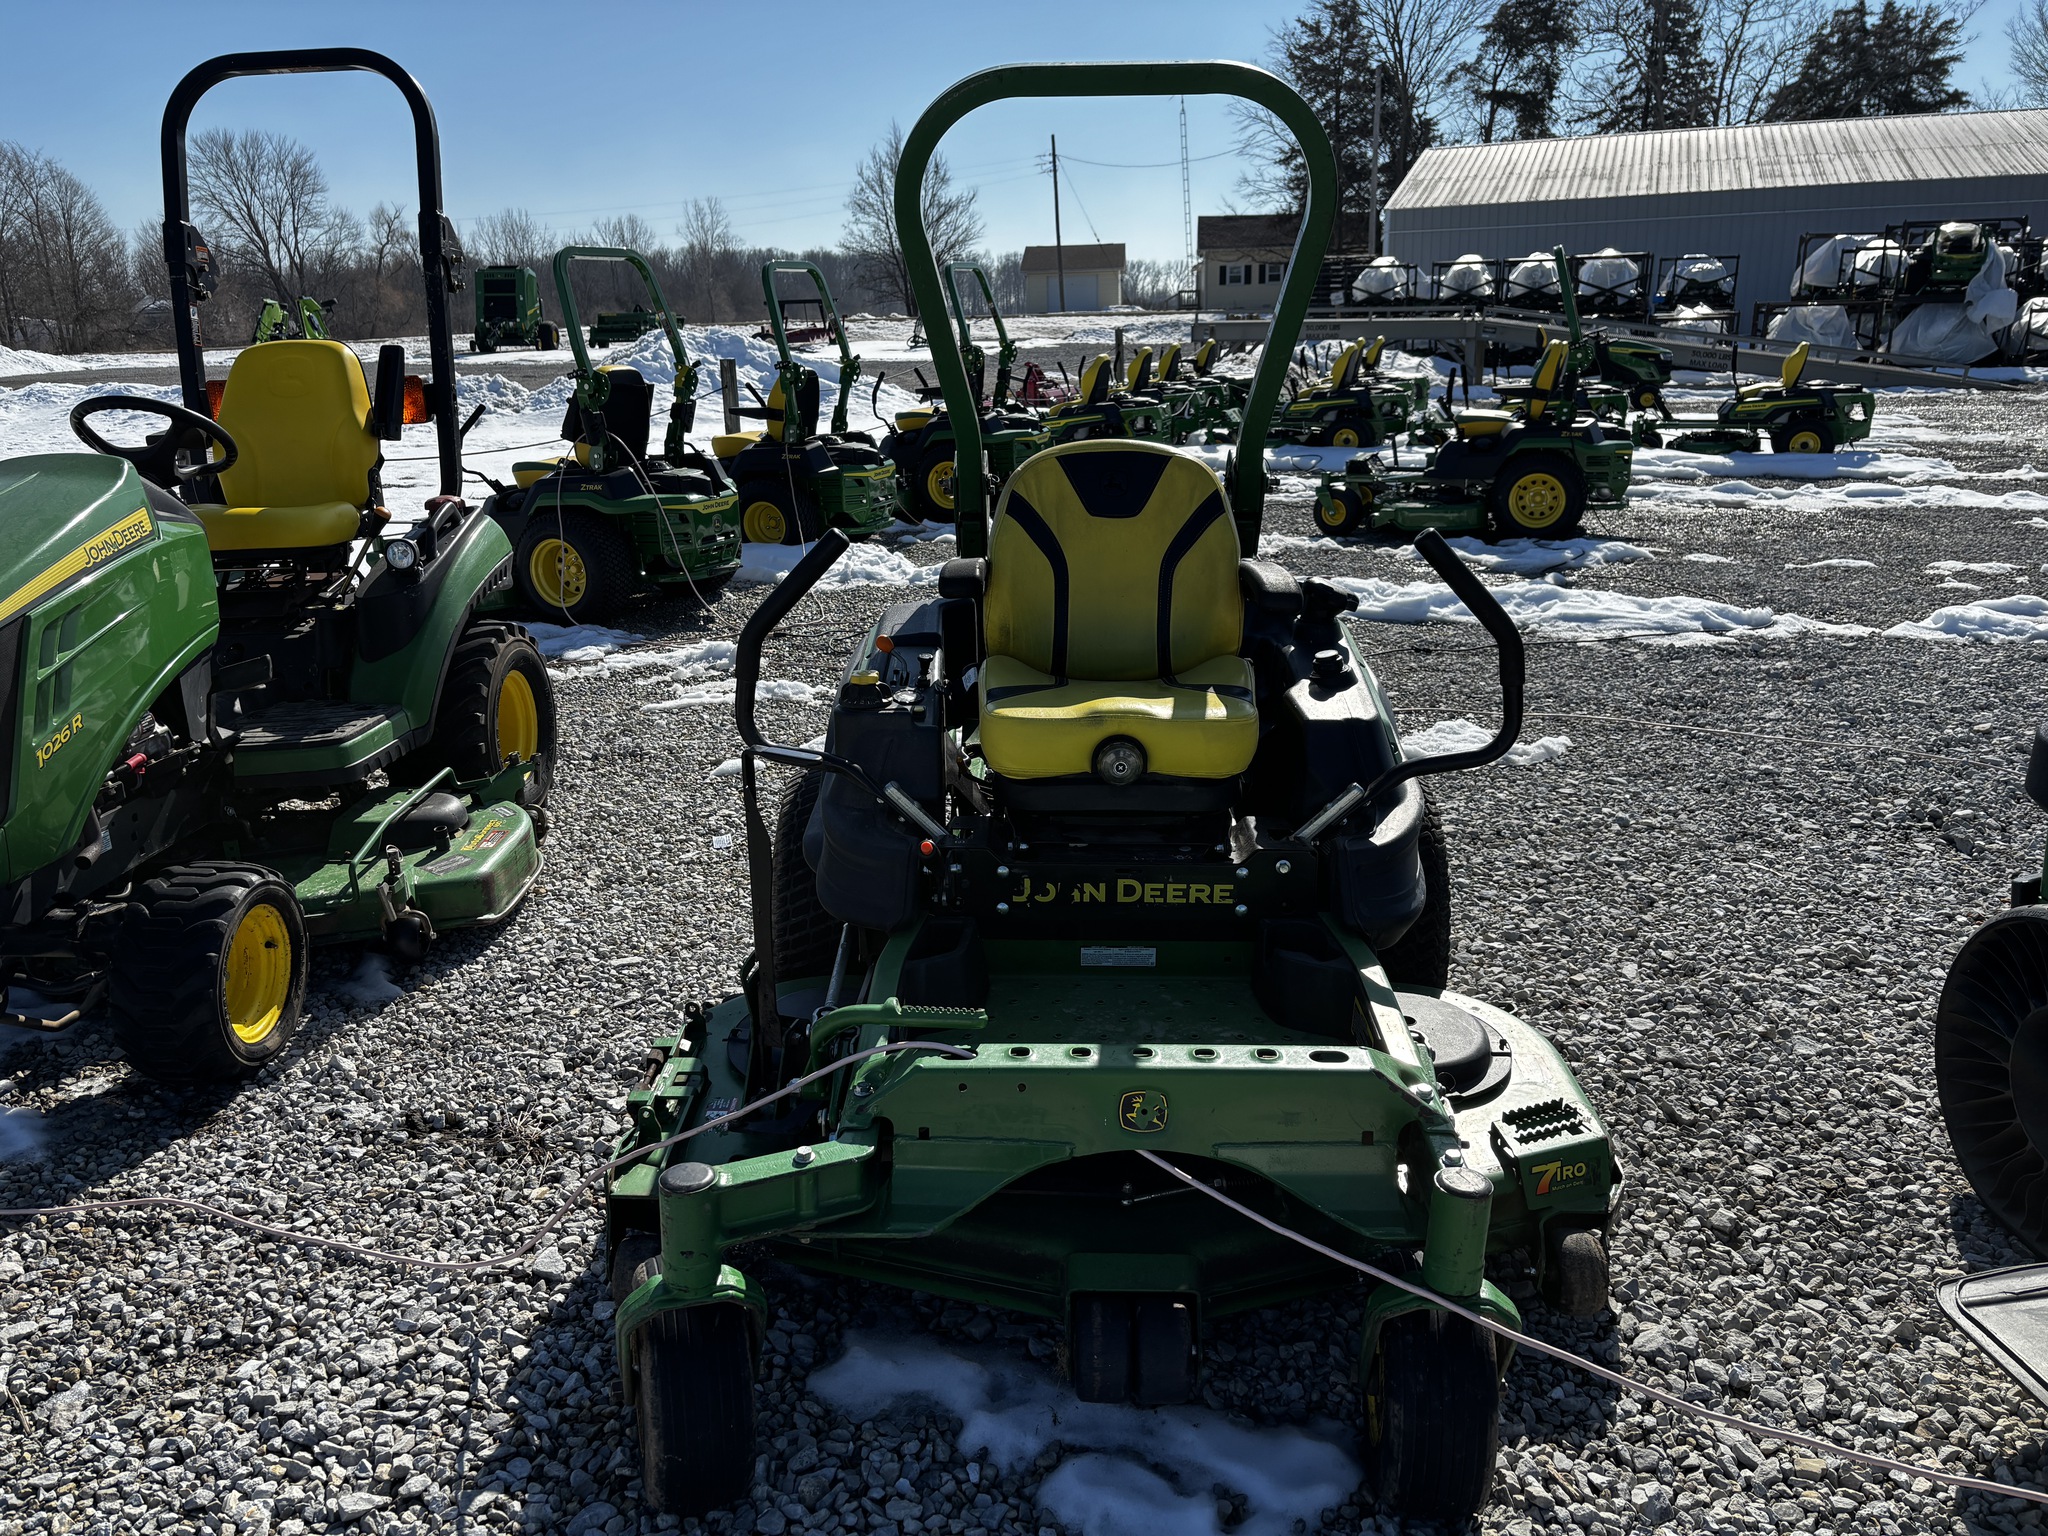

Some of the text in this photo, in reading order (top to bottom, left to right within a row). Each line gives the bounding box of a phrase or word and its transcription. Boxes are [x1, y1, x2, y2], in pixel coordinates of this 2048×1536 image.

[1718, 353, 1732, 361] LBS
[1689, 359, 1728, 370] MAX LOAD
[580, 483, 603, 491] ZTRAK
[703, 500, 729, 511] JOHN DEERE
[83, 520, 148, 566] JOHN DEERE
[36, 712, 84, 769] 1026 R
[1117, 878, 1234, 904] DEERE
